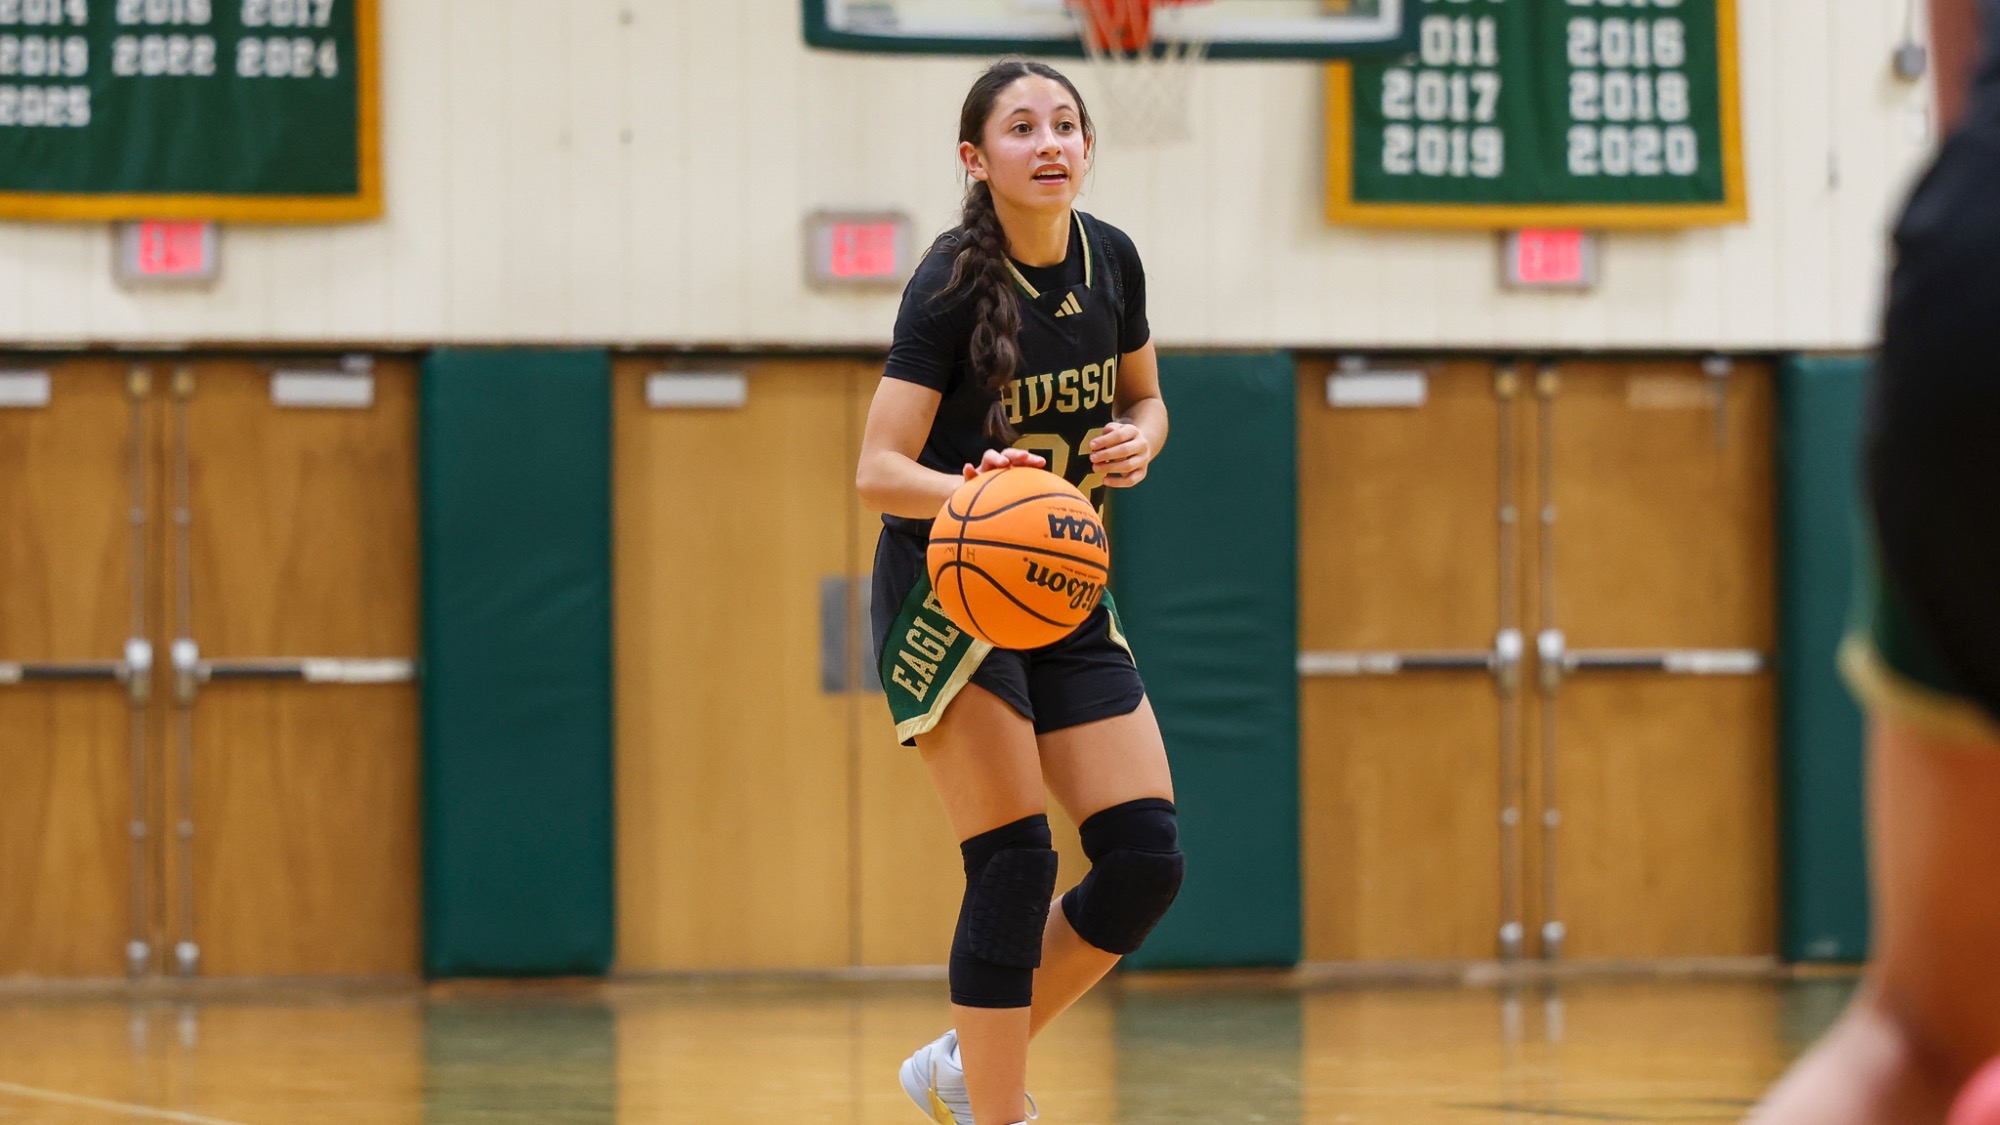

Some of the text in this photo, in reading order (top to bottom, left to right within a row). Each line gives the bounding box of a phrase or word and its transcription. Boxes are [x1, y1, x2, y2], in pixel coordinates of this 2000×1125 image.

[241, 0, 333, 27] 2017
[0, 35, 338, 77] 2019 2022 2024
[1403, 15, 1686, 68] 011 2016
[0, 85, 91, 127] 2025
[1381, 68, 1689, 121] 2017 2018
[1382, 124, 1698, 178] 2019 2020
[1000, 355, 1117, 424] HUSSO
[1047, 514, 1107, 553] NCAA
